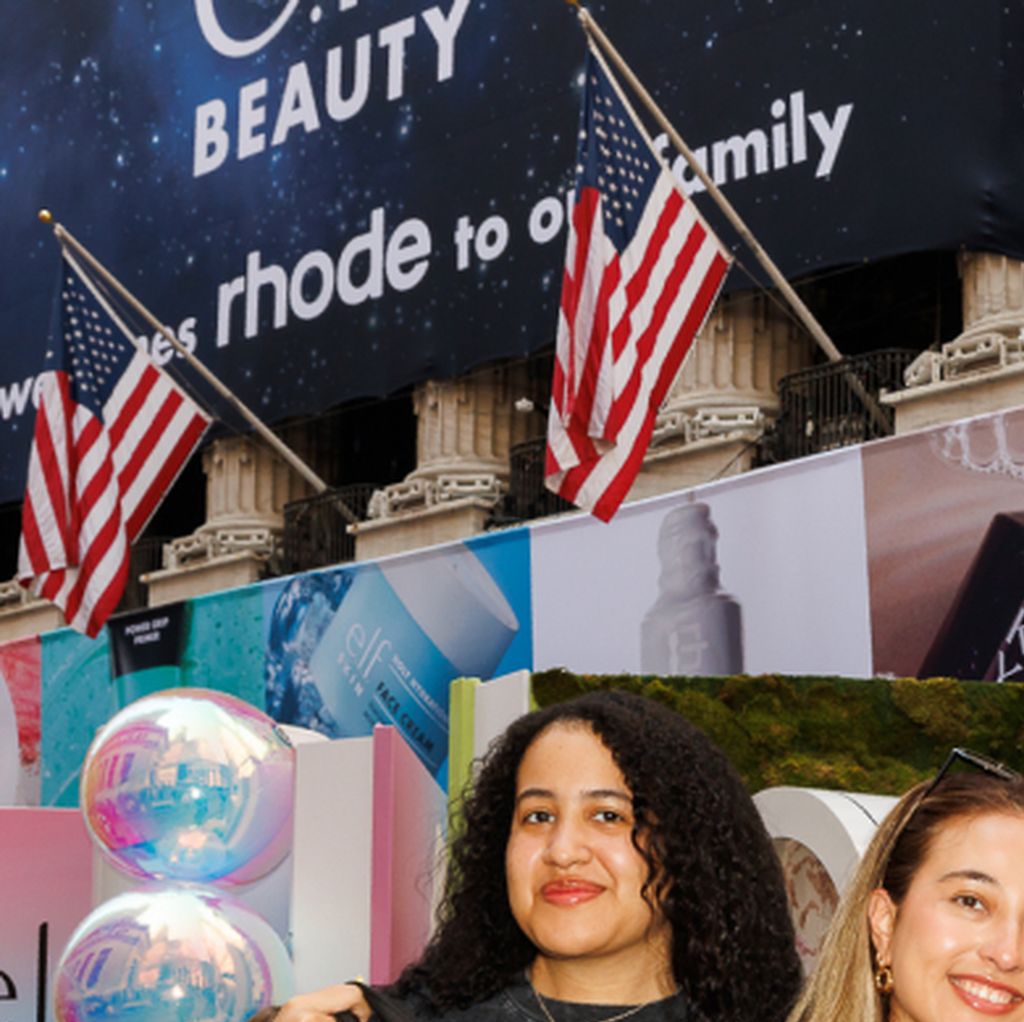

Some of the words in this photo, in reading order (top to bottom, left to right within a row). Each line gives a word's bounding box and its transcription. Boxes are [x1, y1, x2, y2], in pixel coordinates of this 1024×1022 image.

[193, 0, 471, 178] BEAUTY
[217, 207, 430, 348] rhode
[454, 214, 508, 271] to
[376, 681, 400, 714] FACE
